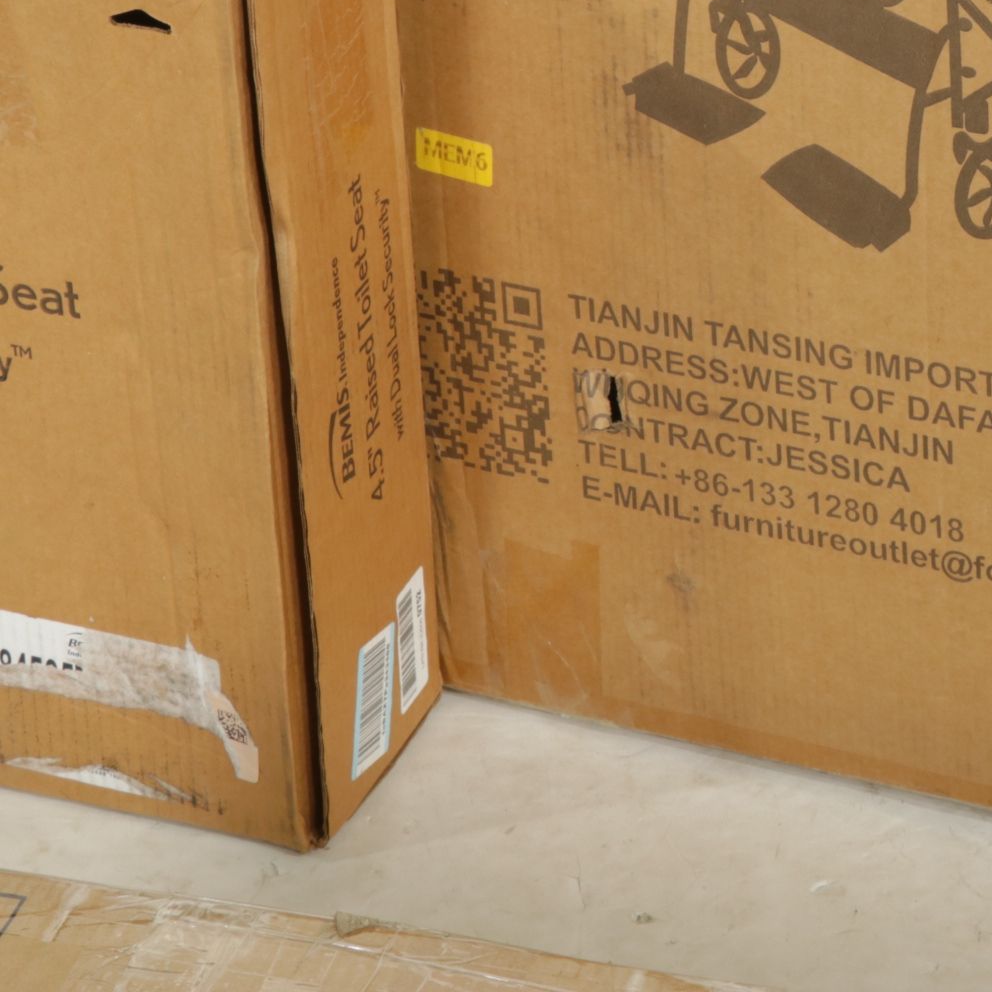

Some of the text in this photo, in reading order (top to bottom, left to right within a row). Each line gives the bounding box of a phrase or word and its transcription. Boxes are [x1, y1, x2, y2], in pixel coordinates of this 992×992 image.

[348, 173, 366, 253] Seat
[354, 249, 372, 339] Toilet
[384, 286, 399, 348] Lock
[568, 294, 693, 341] TIANJIN
[704, 320, 853, 370] TANSING
[331, 256, 356, 482] BEMIS Independence
[359, 333, 381, 440] Raised
[388, 345, 401, 399] Dual
[571, 332, 838, 405] ADDRESS:WEST
[850, 385, 896, 416] OF
[391, 399, 404, 441] with
[719, 396, 955, 464] ZONE,TIANJIN
[578, 440, 964, 542] TELL: +86-133 1280 4018
[582, 476, 700, 523] E-MAIL:
